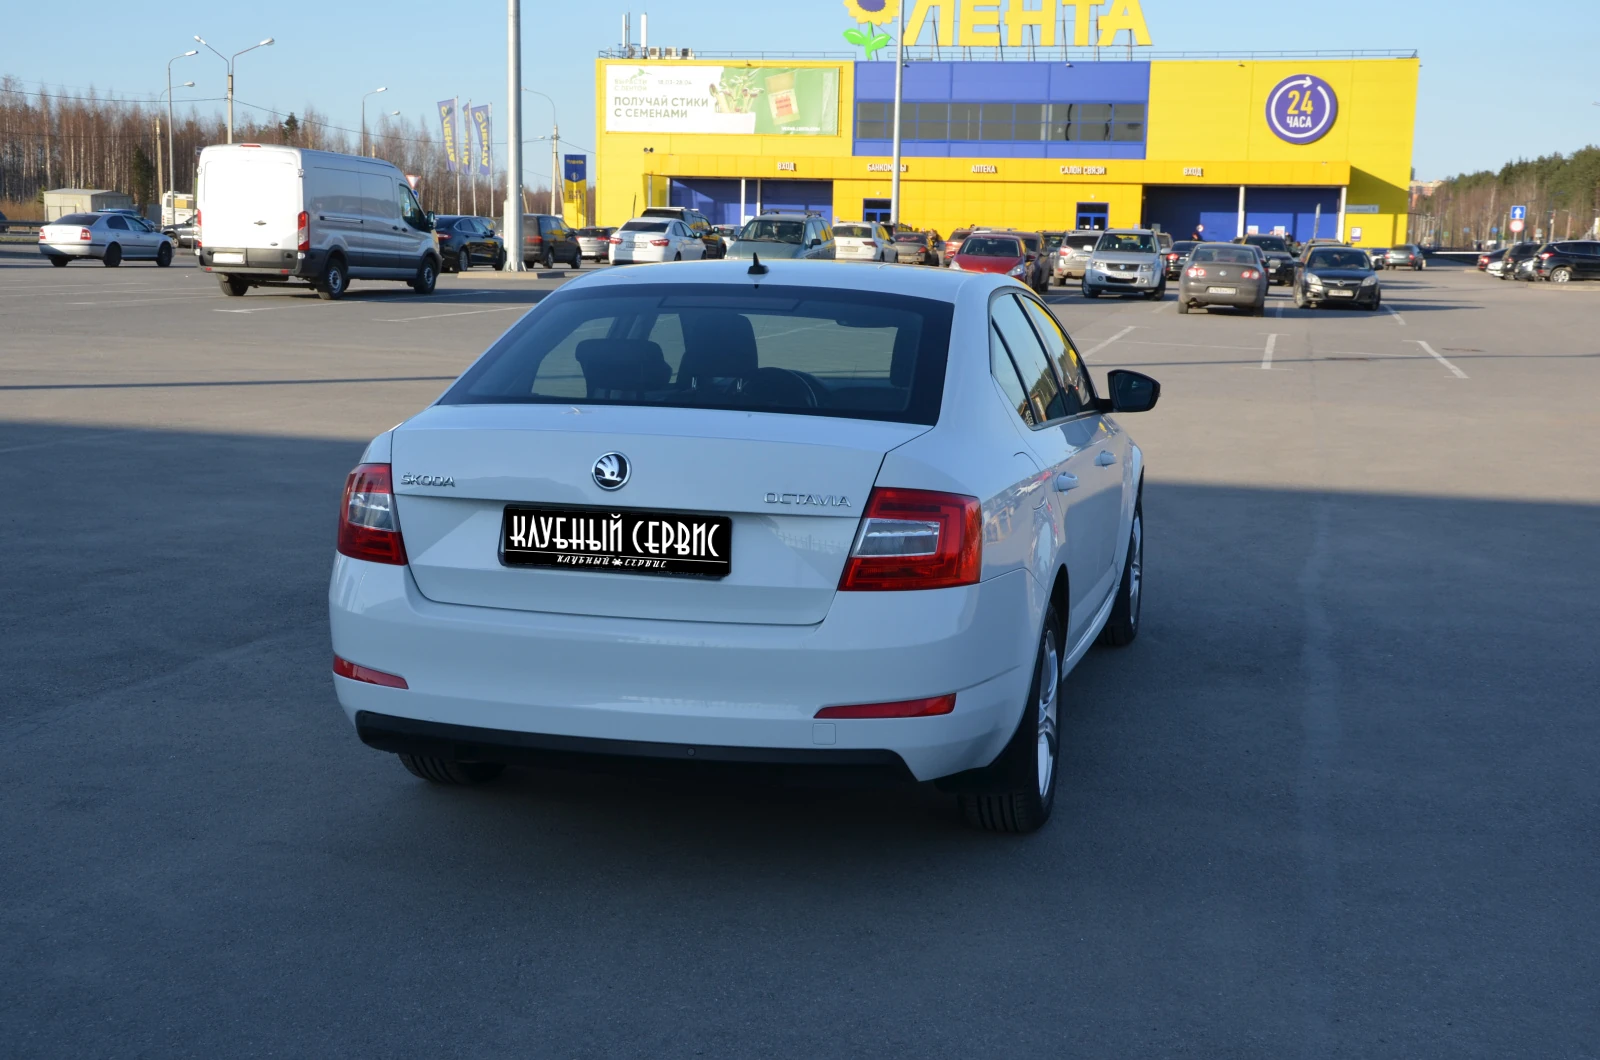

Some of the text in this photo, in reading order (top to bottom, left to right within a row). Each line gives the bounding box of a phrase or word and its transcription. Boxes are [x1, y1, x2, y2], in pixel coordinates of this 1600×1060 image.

[903, 0, 1152, 46] ЛЕНТА
[614, 94, 708, 107] ПОЛУЧАЙ СТИКИ
[1287, 90, 1314, 115] 24
[614, 108, 688, 118] С СЕМЕНАМИ
[1286, 116, 1312, 128] ЧАСА
[777, 161, 795, 172] ВХОД
[867, 163, 907, 173] БАНКОМЫ
[971, 164, 996, 174] АПТЕКА
[1060, 165, 1105, 175] САЛОН СВЯЗИ
[1183, 167, 1202, 177] ВХОД
[401, 472, 455, 488] ŠKODA
[764, 492, 851, 507] OCTAVIA
